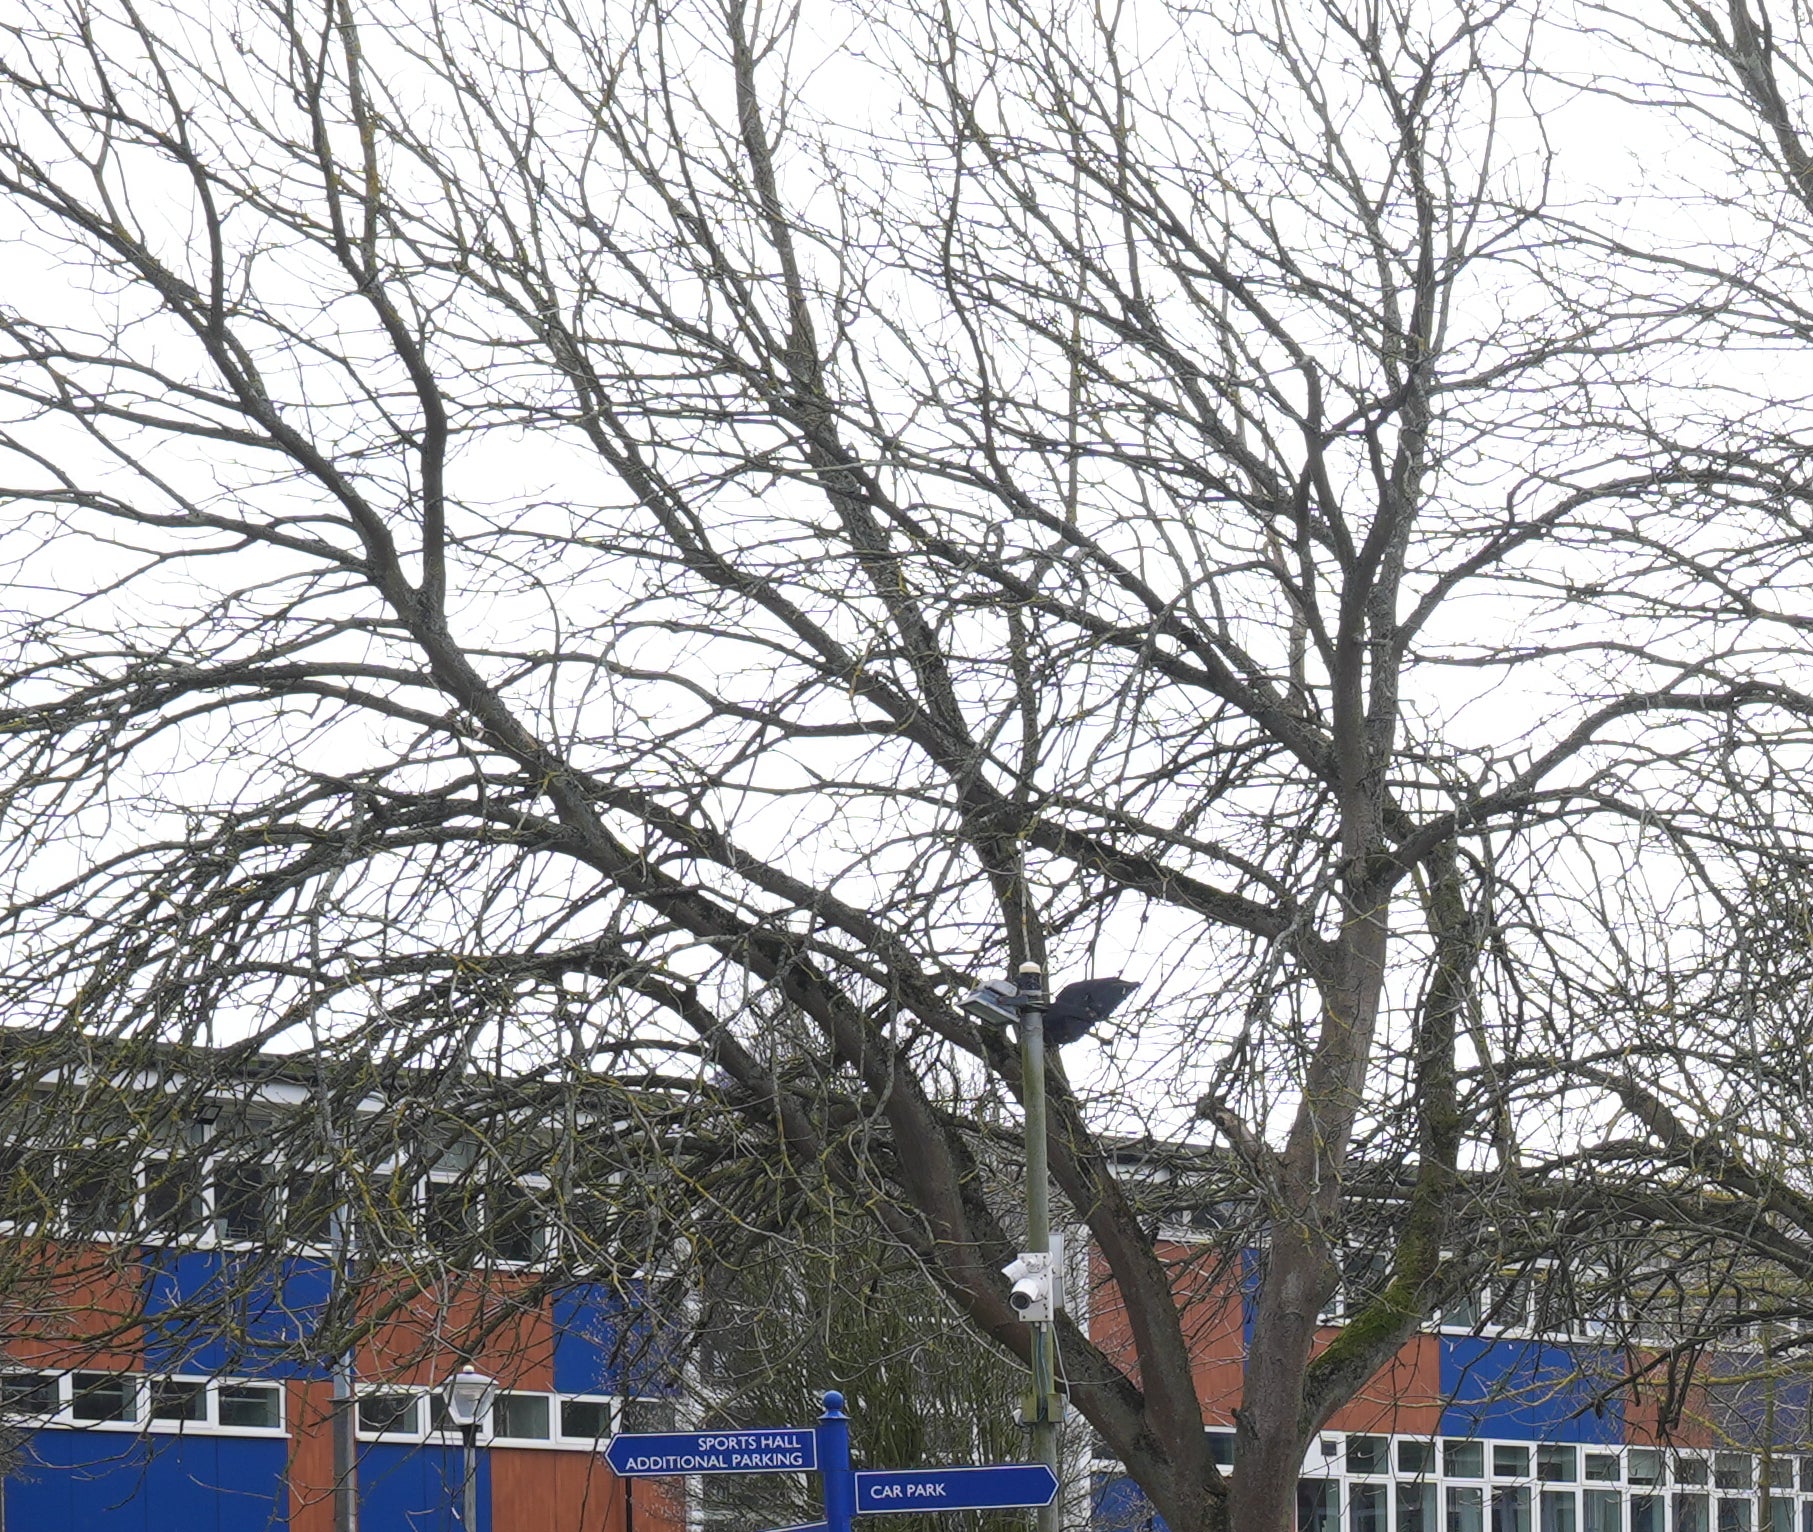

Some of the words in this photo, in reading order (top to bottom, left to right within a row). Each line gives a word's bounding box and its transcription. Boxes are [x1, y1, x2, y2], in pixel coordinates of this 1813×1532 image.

[697, 1436, 758, 1451] SPORTS
[761, 1434, 802, 1449] HALL
[625, 1454, 729, 1471] ADDITIONAL
[731, 1451, 804, 1468] PARKING
[870, 1484, 903, 1499] CAR
[906, 1482, 946, 1498] PARK
